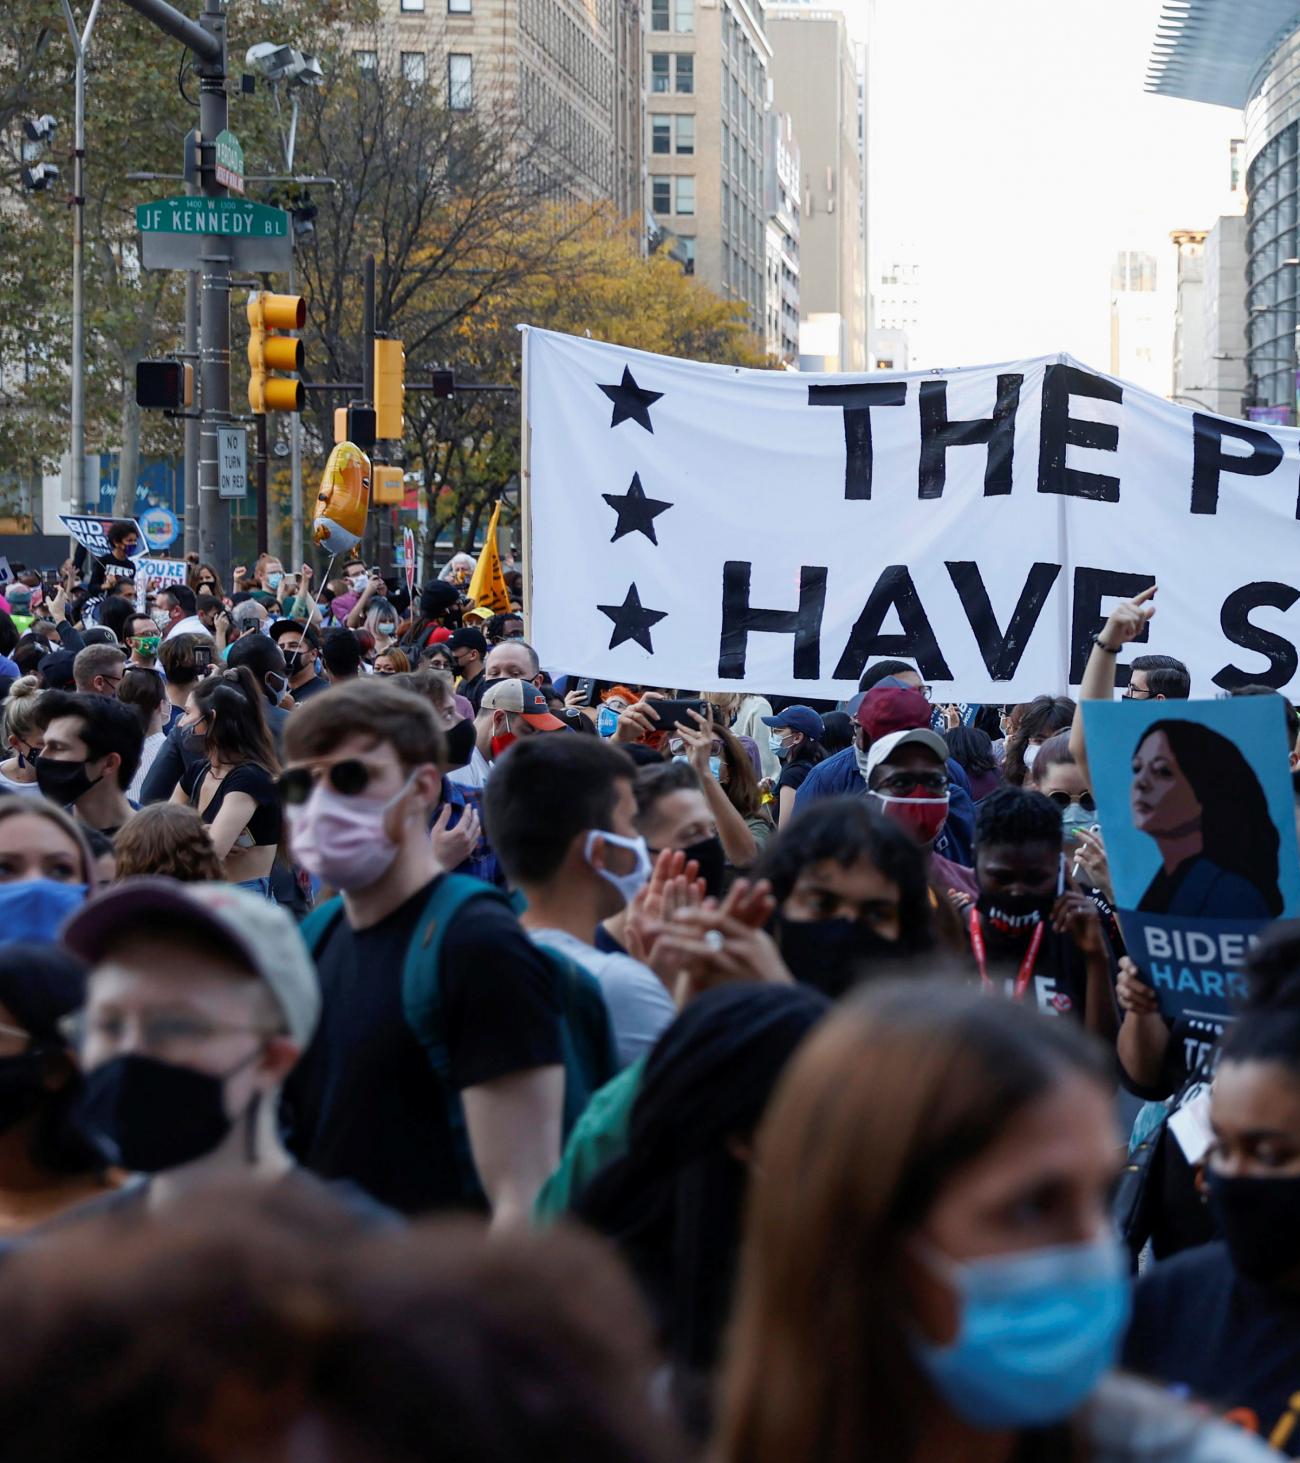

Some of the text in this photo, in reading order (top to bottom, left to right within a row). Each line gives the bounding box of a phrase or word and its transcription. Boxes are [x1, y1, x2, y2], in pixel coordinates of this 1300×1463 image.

[207, 201, 215, 209] W
[142, 210, 282, 235] JF KENNEDY BL
[808, 364, 1123, 502] THE
[226, 436, 239, 449] NO
[224, 456, 242, 469] TURN
[221, 475, 245, 489] ON RED
[718, 561, 1157, 688] HAVE
